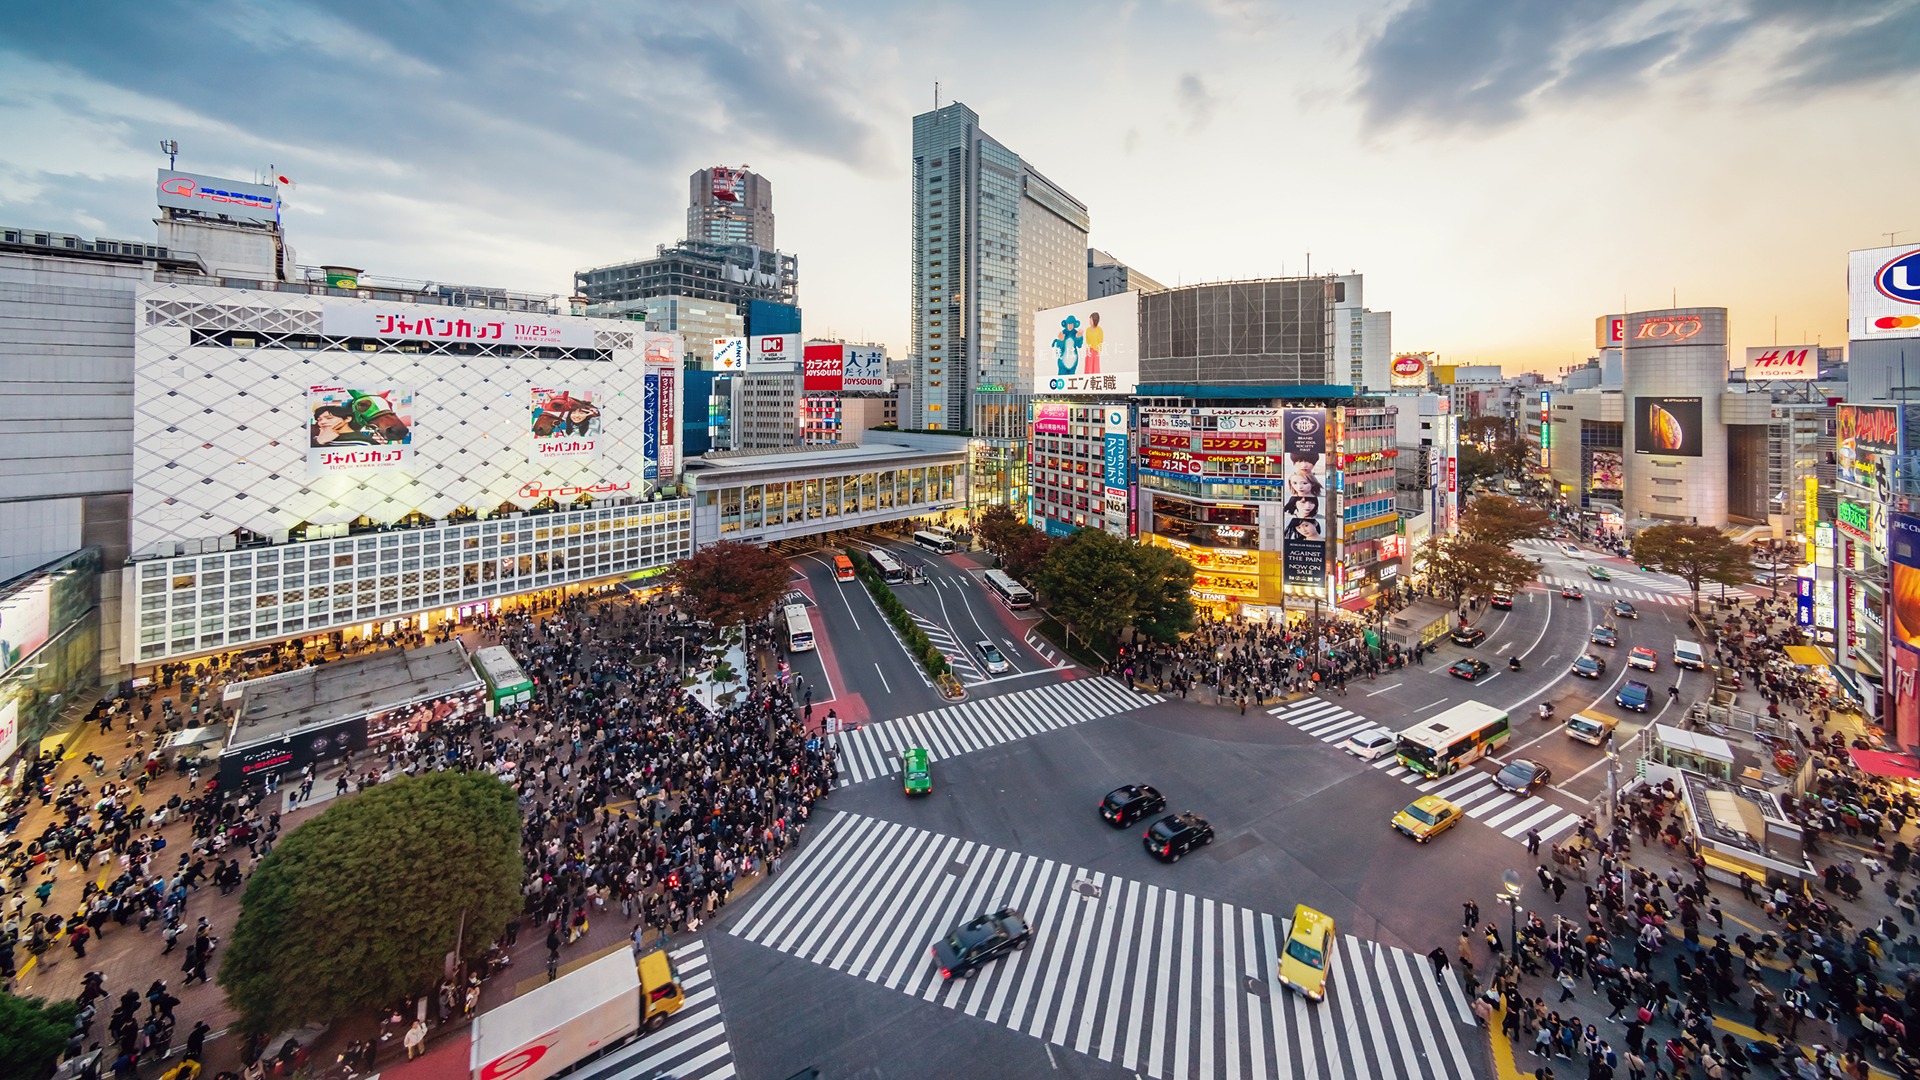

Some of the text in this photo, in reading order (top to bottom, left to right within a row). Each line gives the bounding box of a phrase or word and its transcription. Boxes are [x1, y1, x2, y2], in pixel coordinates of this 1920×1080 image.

[195, 193, 273, 209] TOKYU
[376, 315, 506, 339] ジャパンカップ
[514, 324, 547, 336] 11/25
[1635, 320, 1702, 342] 109
[806, 359, 841, 369] カラオケ
[845, 351, 882, 368] 大声
[1755, 349, 1808, 367] H&M
[806, 369, 842, 377] JOYSOUND
[844, 378, 882, 386] JOYSOUND
[1068, 375, 1116, 391] エン転職
[1239, 418, 1279, 428] しゃぶ葉
[538, 440, 595, 452] ジャパンカップ
[1203, 439, 1264, 449] コンタクト
[320, 450, 404, 464] ジャパンカップ
[1107, 437, 1116, 484] アイシティ
[1173, 451, 1192, 461] ガスト
[1245, 455, 1274, 464] ガスト
[1163, 460, 1186, 471] ガスト
[540, 482, 630, 496] TOKYU
[1106, 499, 1126, 513] No.1
[1381, 564, 1396, 577] LUSH
[242, 753, 293, 773] G-SHOCK
